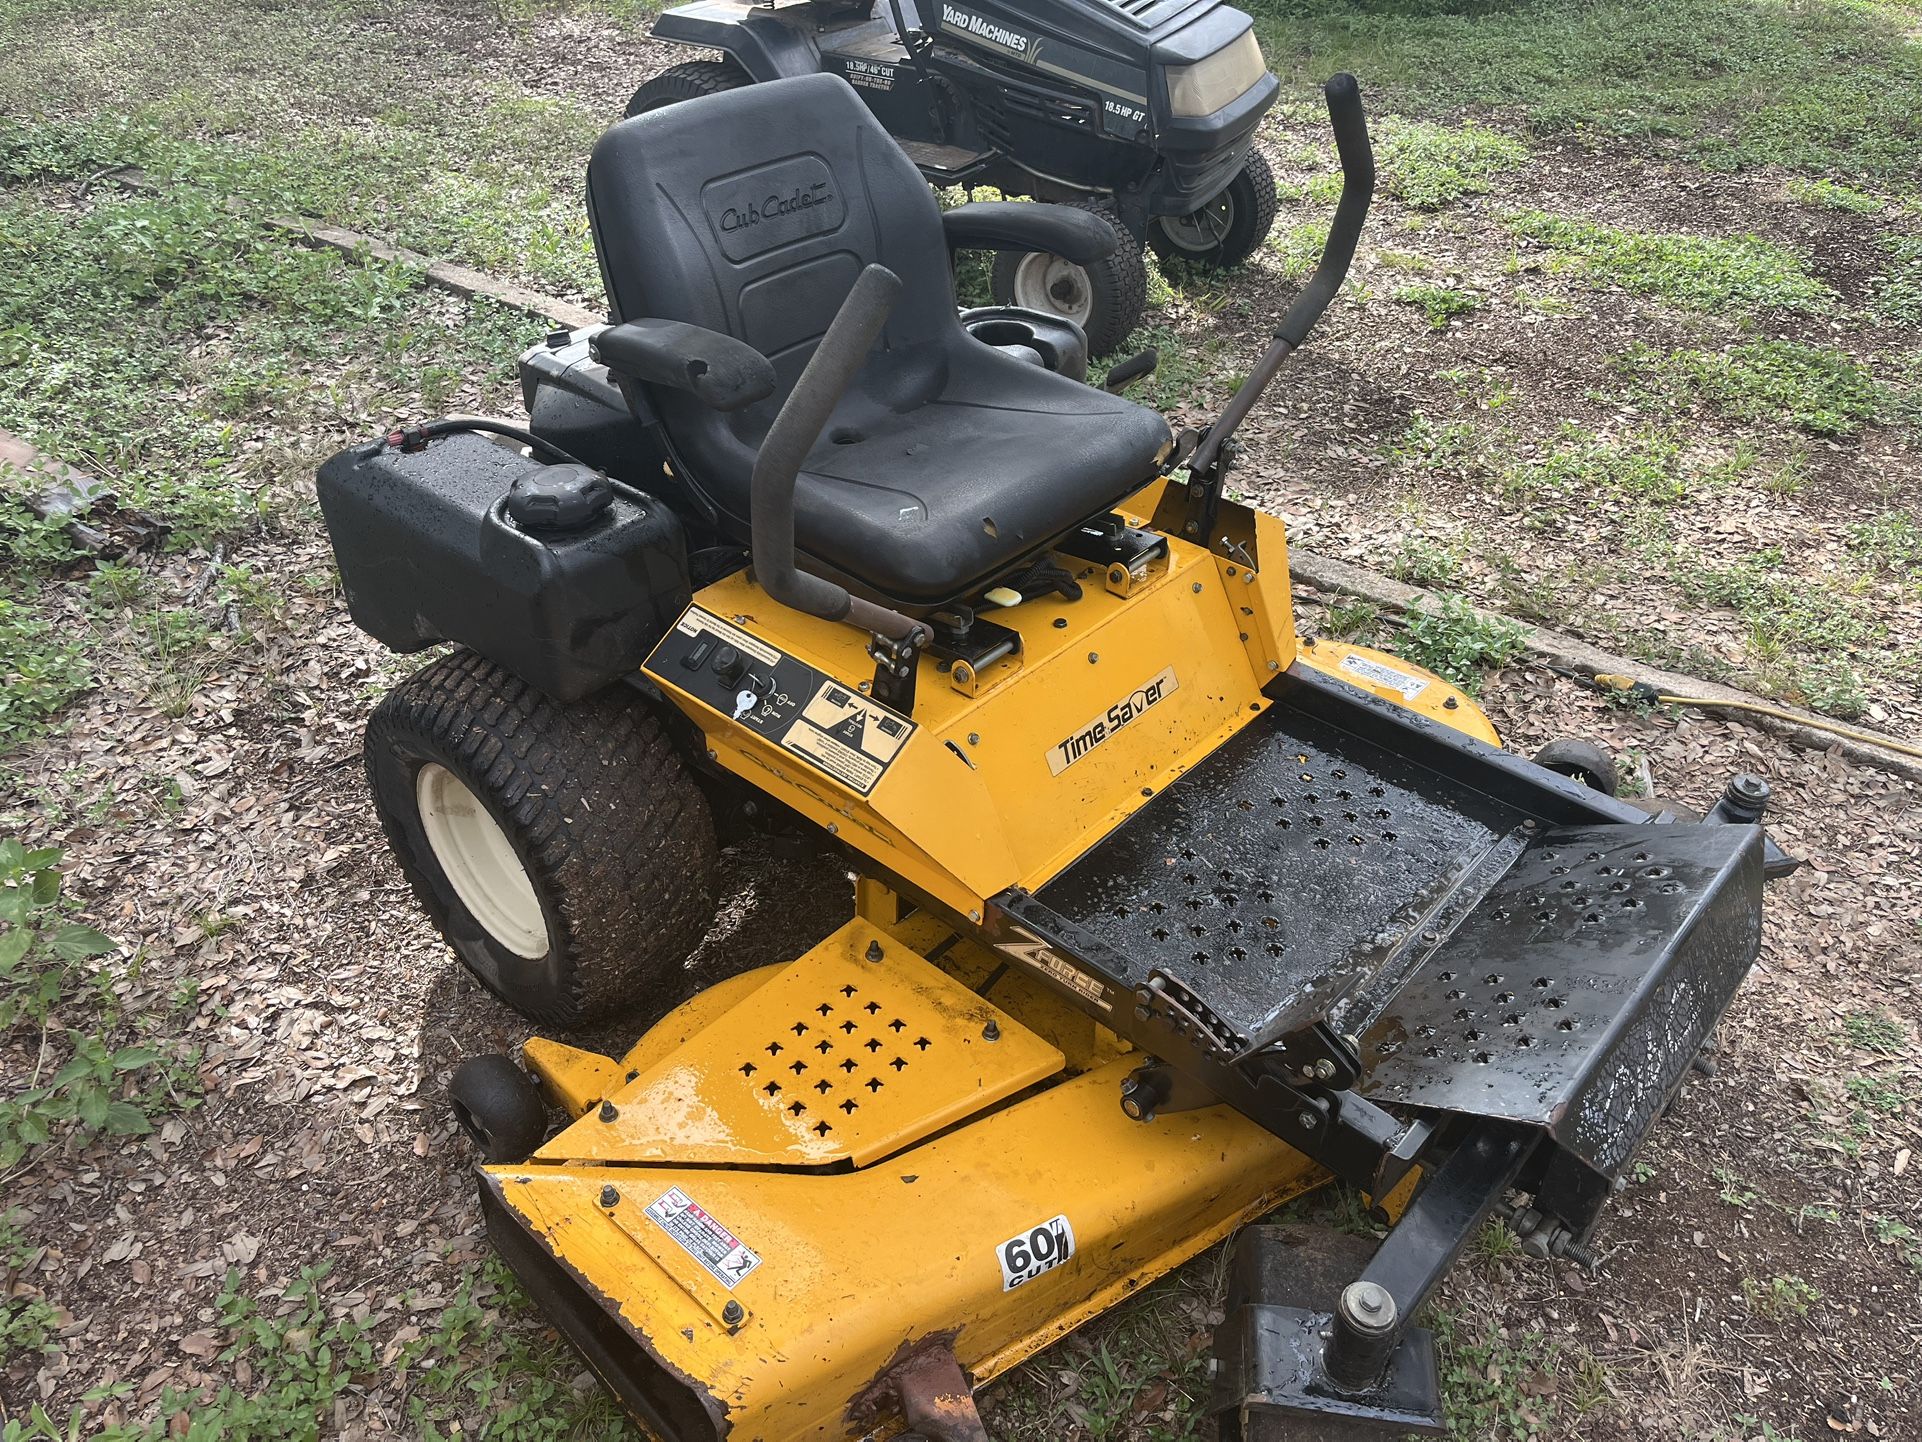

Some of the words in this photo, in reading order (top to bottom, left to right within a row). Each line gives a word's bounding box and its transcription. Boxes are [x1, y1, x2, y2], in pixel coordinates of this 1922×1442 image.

[943, 4, 969, 28] YARD
[968, 15, 1028, 51] MACHINES
[881, 66, 894, 77] CUT
[1105, 100, 1122, 115] 18.5
[1120, 105, 1133, 118] HP
[1132, 110, 1146, 122] GT
[720, 203, 760, 233] Cub
[761, 182, 828, 219] Cadet
[680, 621, 698, 634] NOTICE
[750, 714, 764, 724] START
[1058, 721, 1106, 765] Time
[1107, 678, 1165, 733] Saver
[1037, 949, 1105, 998] FORCE
[1059, 976, 1077, 991] TURN
[1078, 988, 1099, 1003] RIDER
[700, 1214, 733, 1243] DANGER
[1008, 1257, 1057, 1288] CUT
